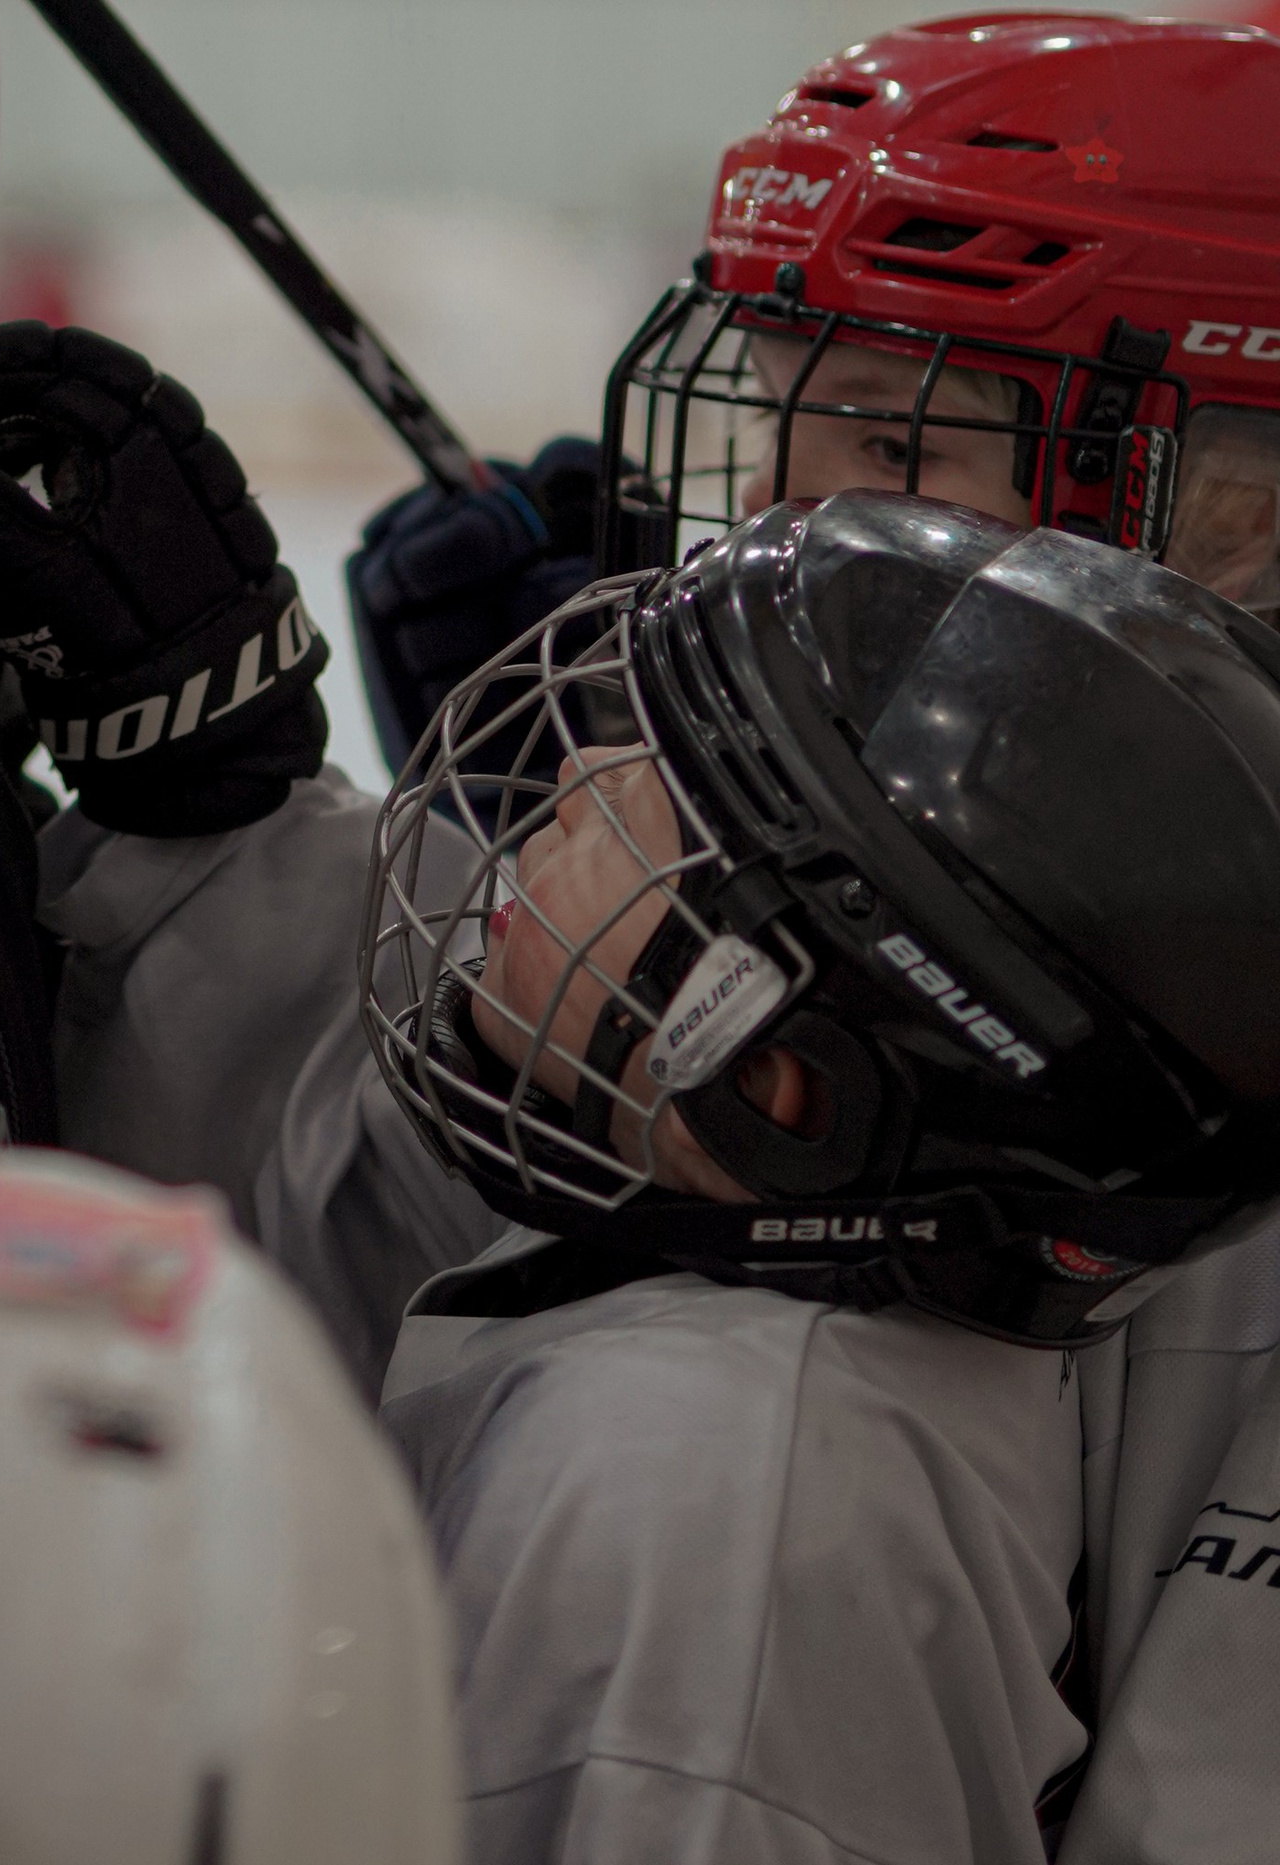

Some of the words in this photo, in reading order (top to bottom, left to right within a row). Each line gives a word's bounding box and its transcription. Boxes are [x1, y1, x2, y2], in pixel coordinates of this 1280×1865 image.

[727, 166, 834, 211] CCM
[1119, 431, 1150, 549] CCM
[667, 956, 755, 1050] BAUER
[875, 932, 1048, 1080] BAUER
